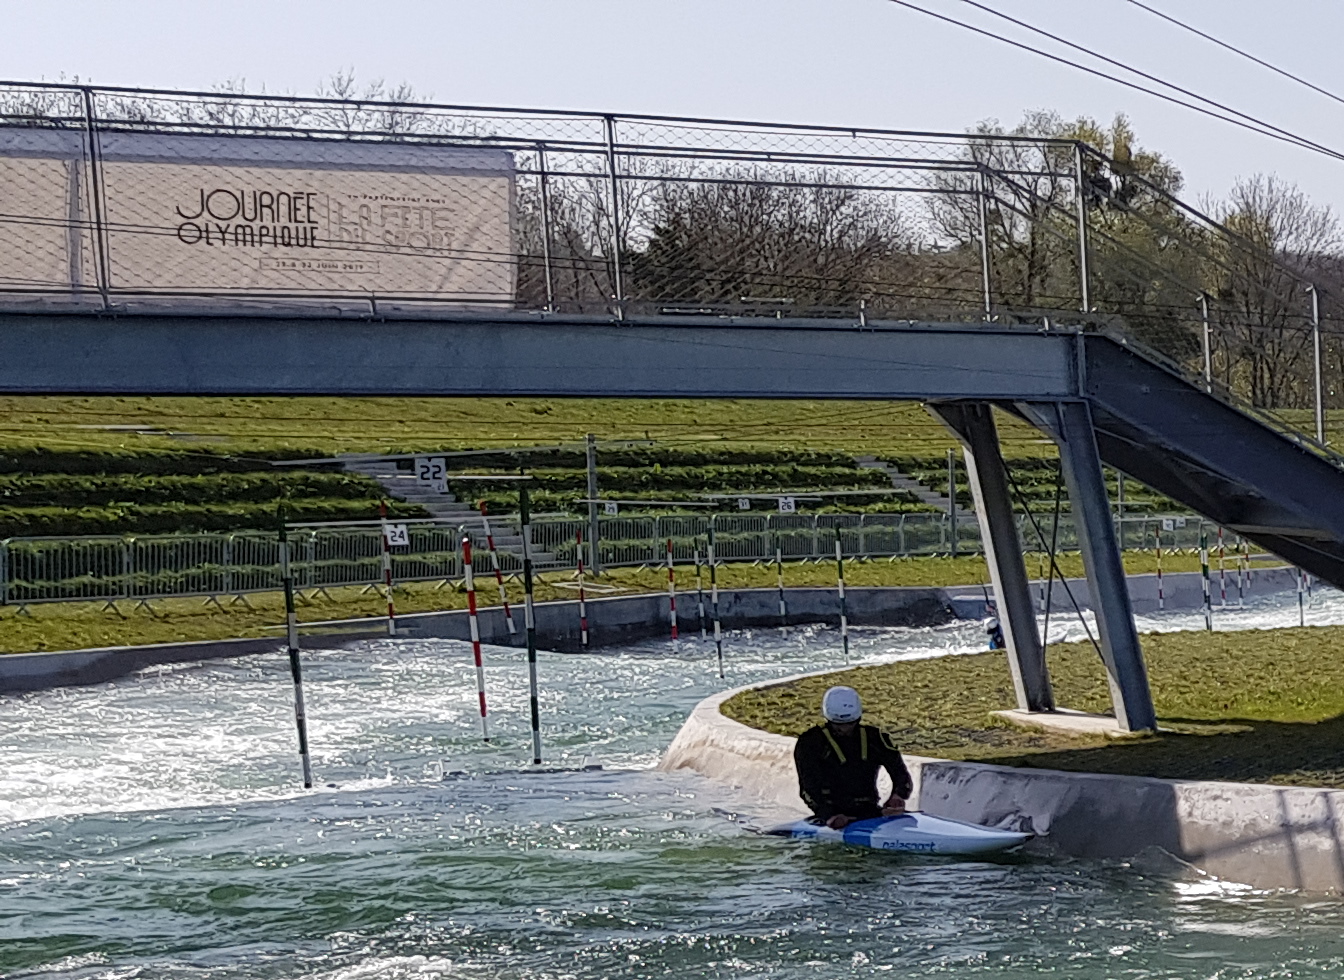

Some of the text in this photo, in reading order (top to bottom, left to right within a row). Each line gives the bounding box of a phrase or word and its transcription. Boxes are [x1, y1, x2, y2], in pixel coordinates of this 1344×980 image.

[176, 188, 319, 224] JOURNÉE
[177, 221, 319, 248] OLYMPIQUE
[419, 464, 443, 481] 22
[781, 501, 793, 511] 26
[389, 530, 406, 543] 24
